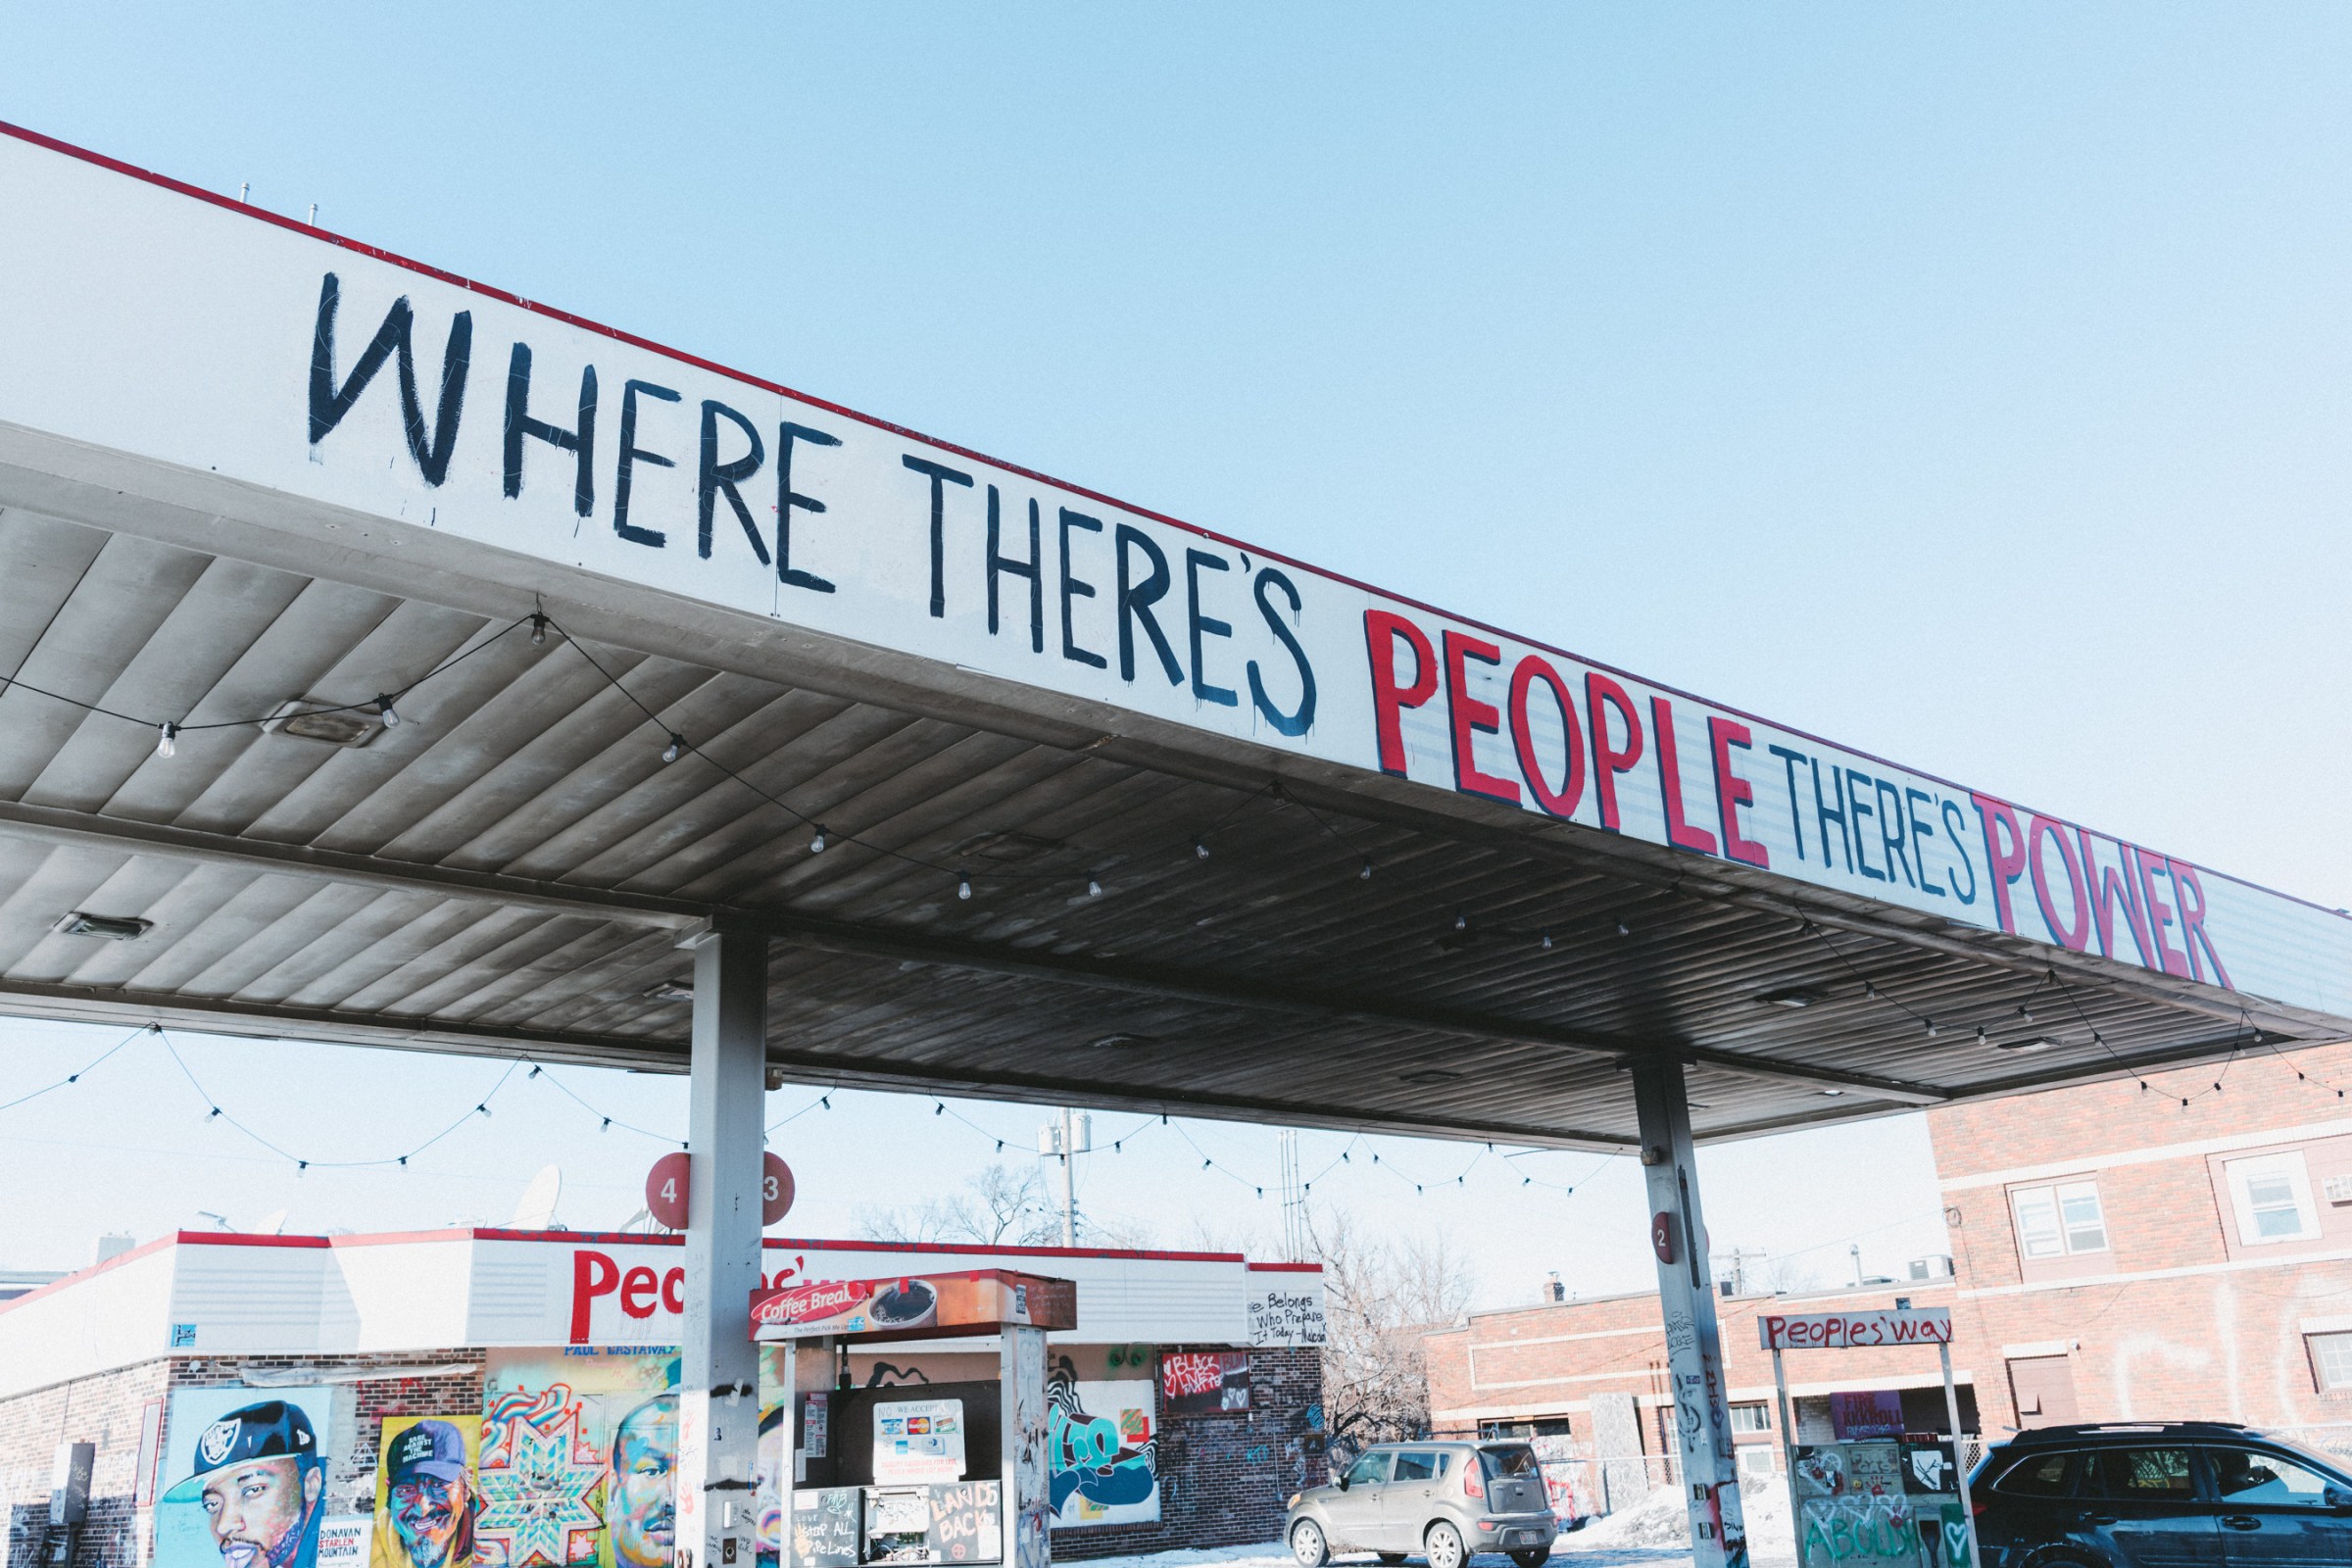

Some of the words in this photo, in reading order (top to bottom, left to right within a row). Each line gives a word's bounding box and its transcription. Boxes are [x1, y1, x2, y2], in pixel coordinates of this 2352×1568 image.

[309, 271, 843, 594] WHERE
[902, 454, 1317, 741] THERE'S
[1363, 609, 1771, 870] PEOPLE
[1769, 744, 1976, 906] THERE'S
[1970, 790, 2235, 991] POWER
[661, 1178, 677, 1203] 4
[763, 1176, 779, 1201] 3
[1657, 1229, 1666, 1247] 2
[760, 1297, 807, 1320] Coffee
[810, 1284, 852, 1310] Break
[1268, 1292, 1313, 1312] Belongs
[1256, 1312, 1282, 1329] Who
[1285, 1309, 1324, 1327] Prepare
[1270, 1326, 1294, 1347] Today
[319, 1528, 362, 1540] DONAVAN
[833, 1521, 855, 1537] ALL
[939, 1509, 989, 1543] BACK
[318, 1538, 354, 1549] STARLEN
[318, 1545, 359, 1558] MOUNTAIN
